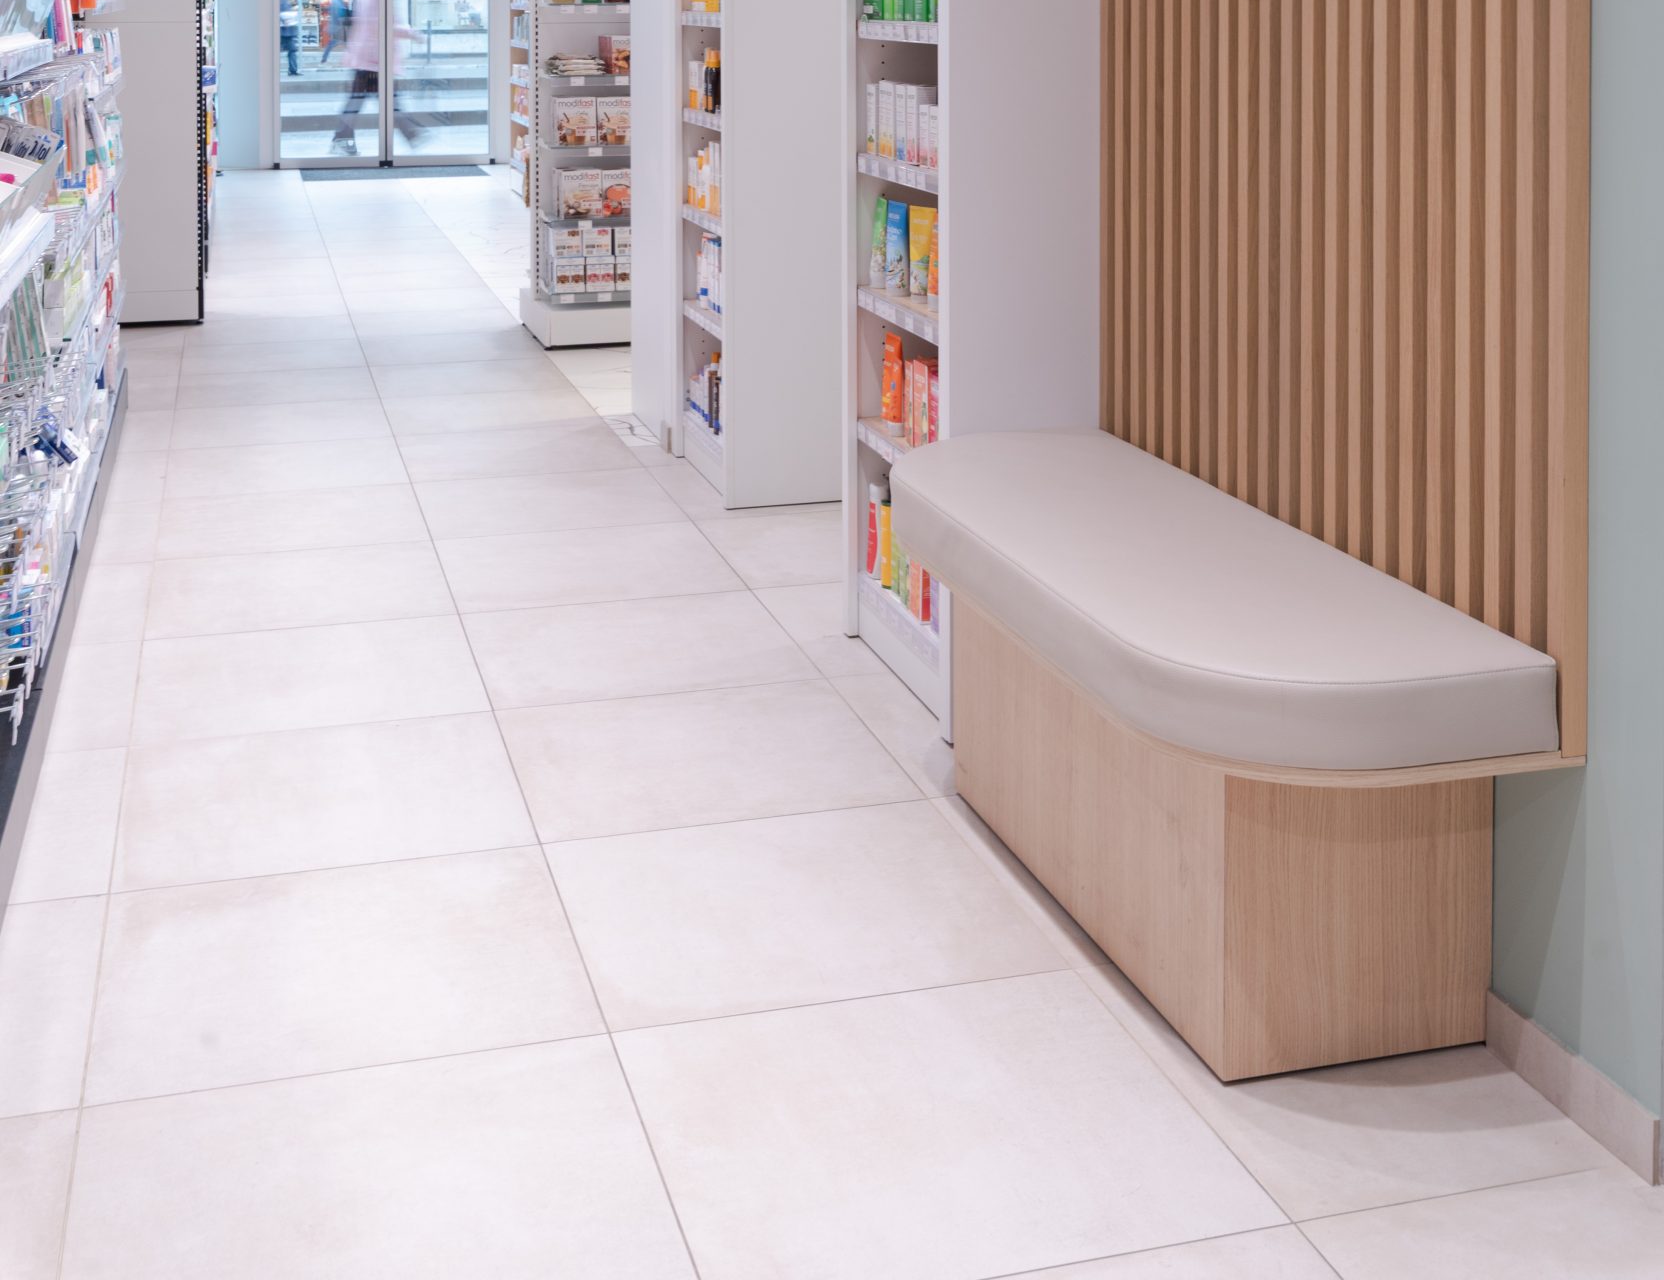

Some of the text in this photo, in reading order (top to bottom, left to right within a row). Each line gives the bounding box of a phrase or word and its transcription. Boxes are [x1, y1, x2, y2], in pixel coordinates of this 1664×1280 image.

[558, 99, 593, 108] modifast
[599, 99, 631, 108] modifas
[563, 172, 600, 181] modifast
